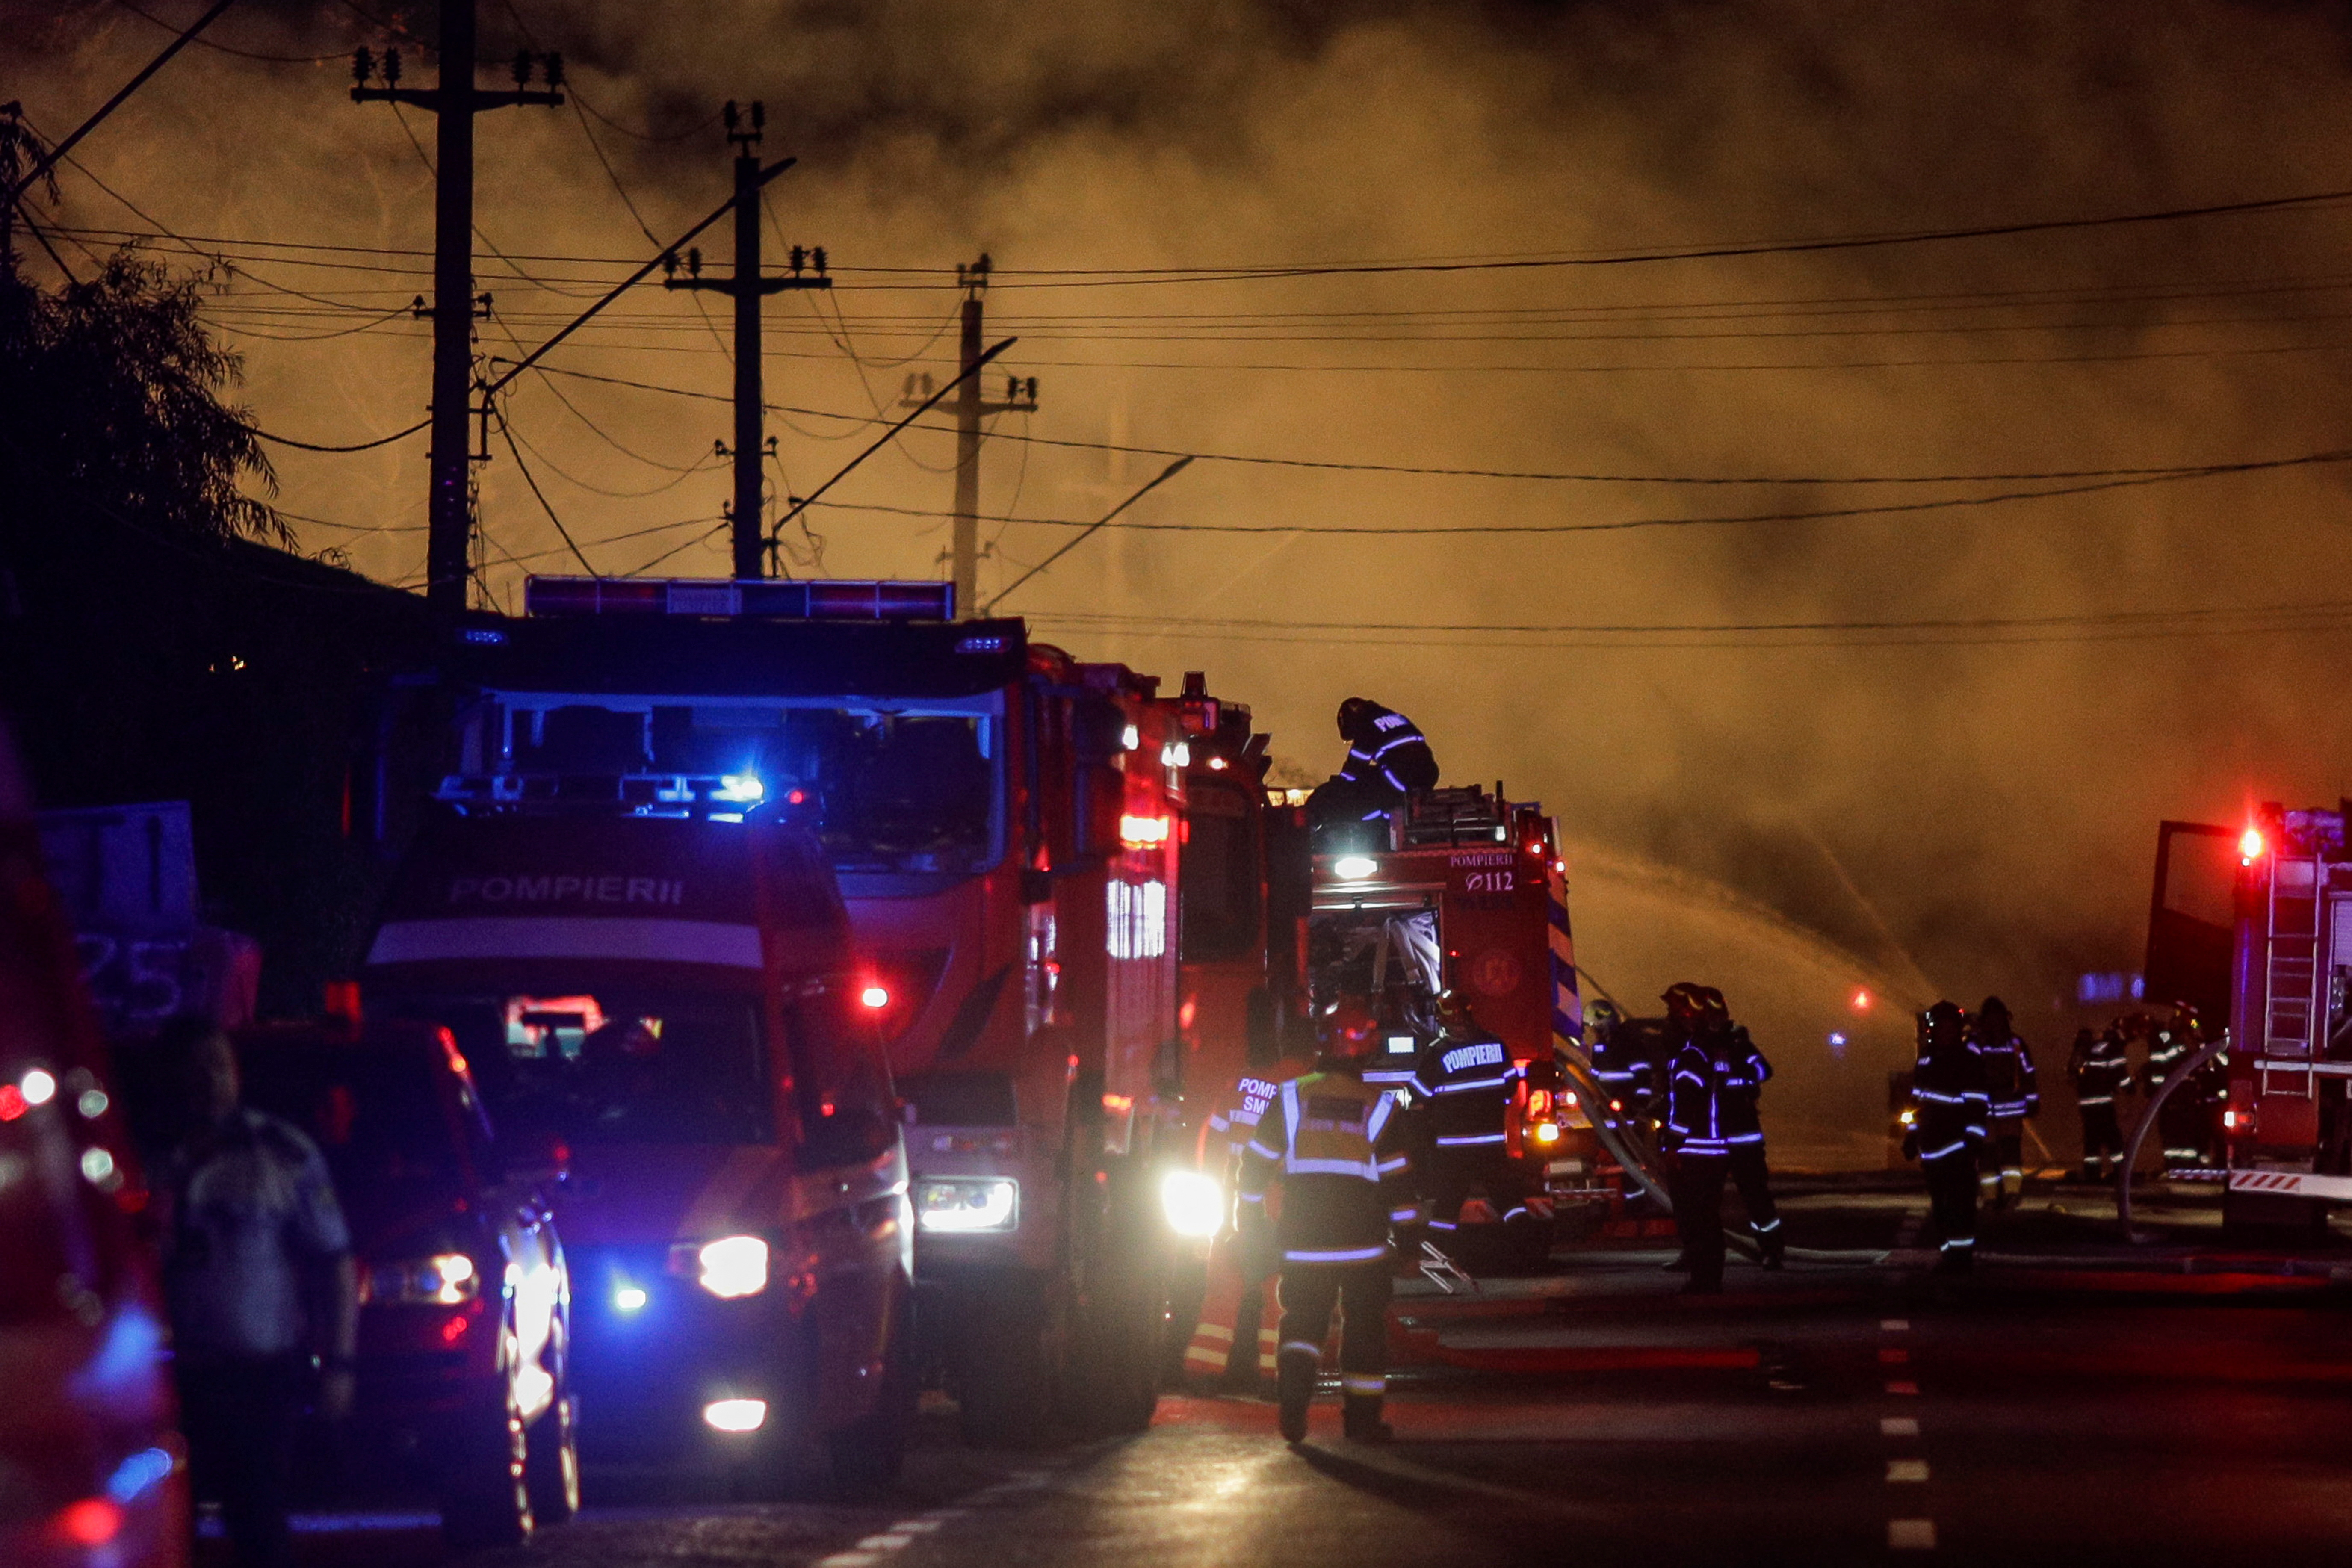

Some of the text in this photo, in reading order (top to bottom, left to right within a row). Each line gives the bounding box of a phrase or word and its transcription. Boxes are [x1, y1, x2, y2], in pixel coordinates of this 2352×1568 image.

[1451, 854, 1513, 867] POMPIERII
[449, 875, 683, 904] POMPIERII
[1486, 871, 1514, 891] 112
[1243, 1096, 1270, 1115] SM
